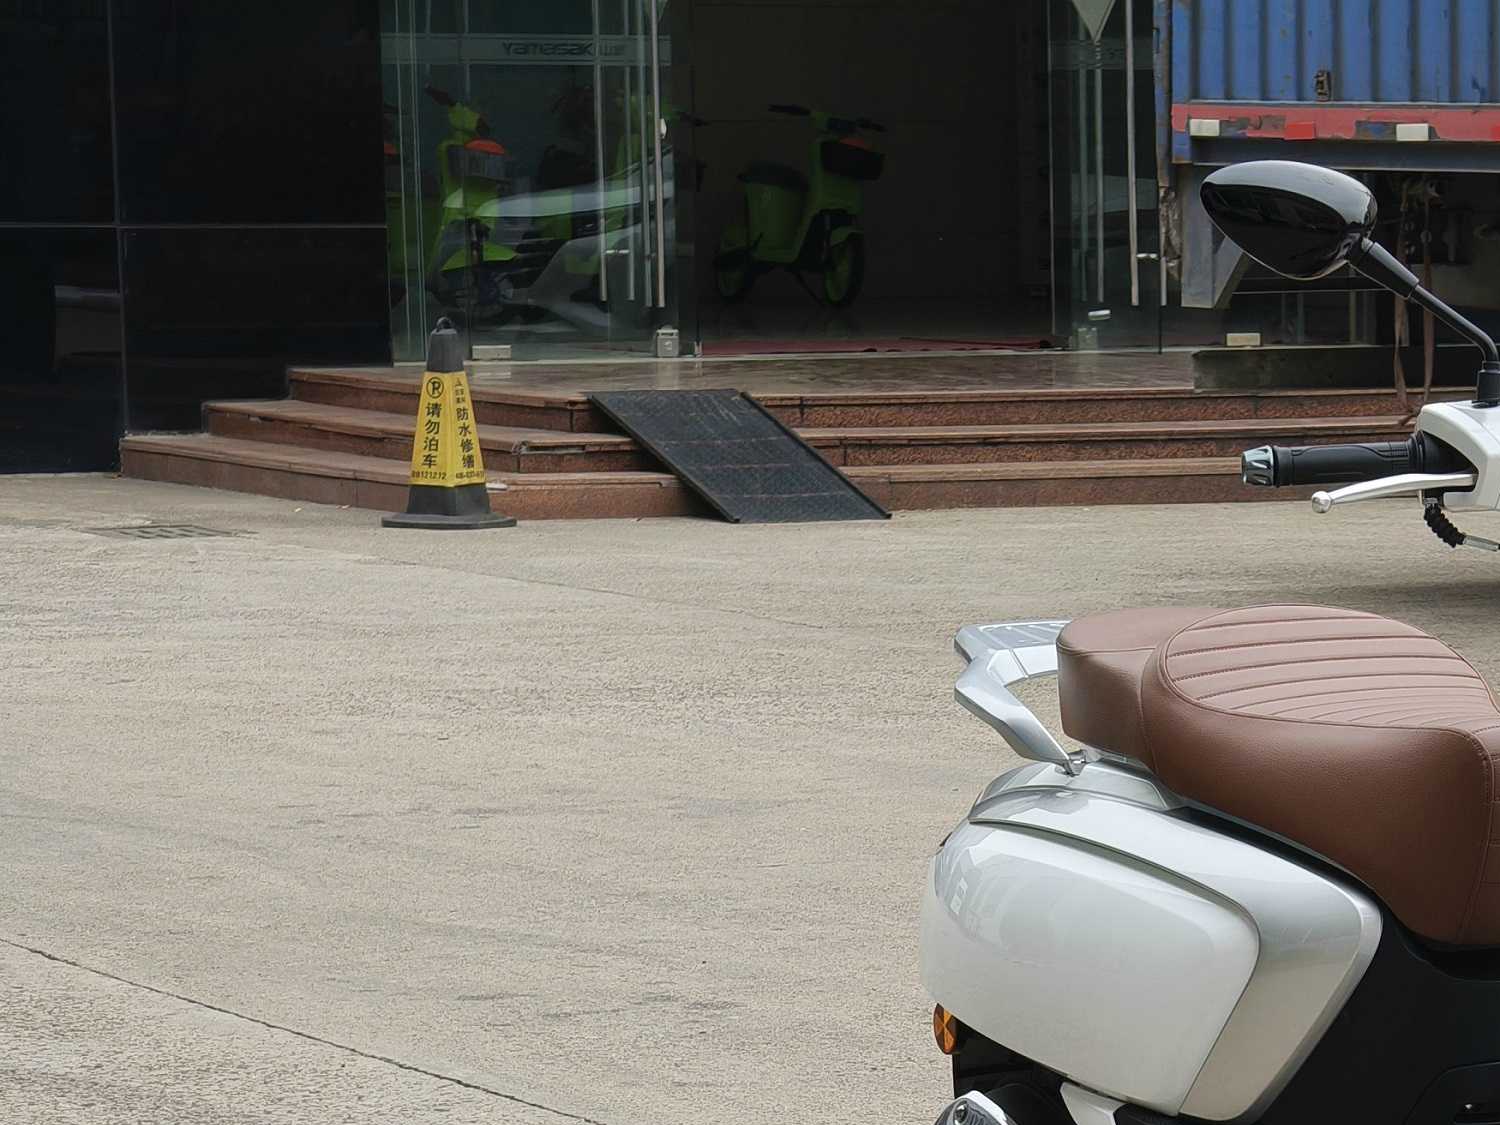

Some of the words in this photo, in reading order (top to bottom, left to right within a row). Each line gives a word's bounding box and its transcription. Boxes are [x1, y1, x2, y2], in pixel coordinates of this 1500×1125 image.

[502, 40, 597, 56] Yamasak
[421, 402, 442, 469] 请勿泊车
